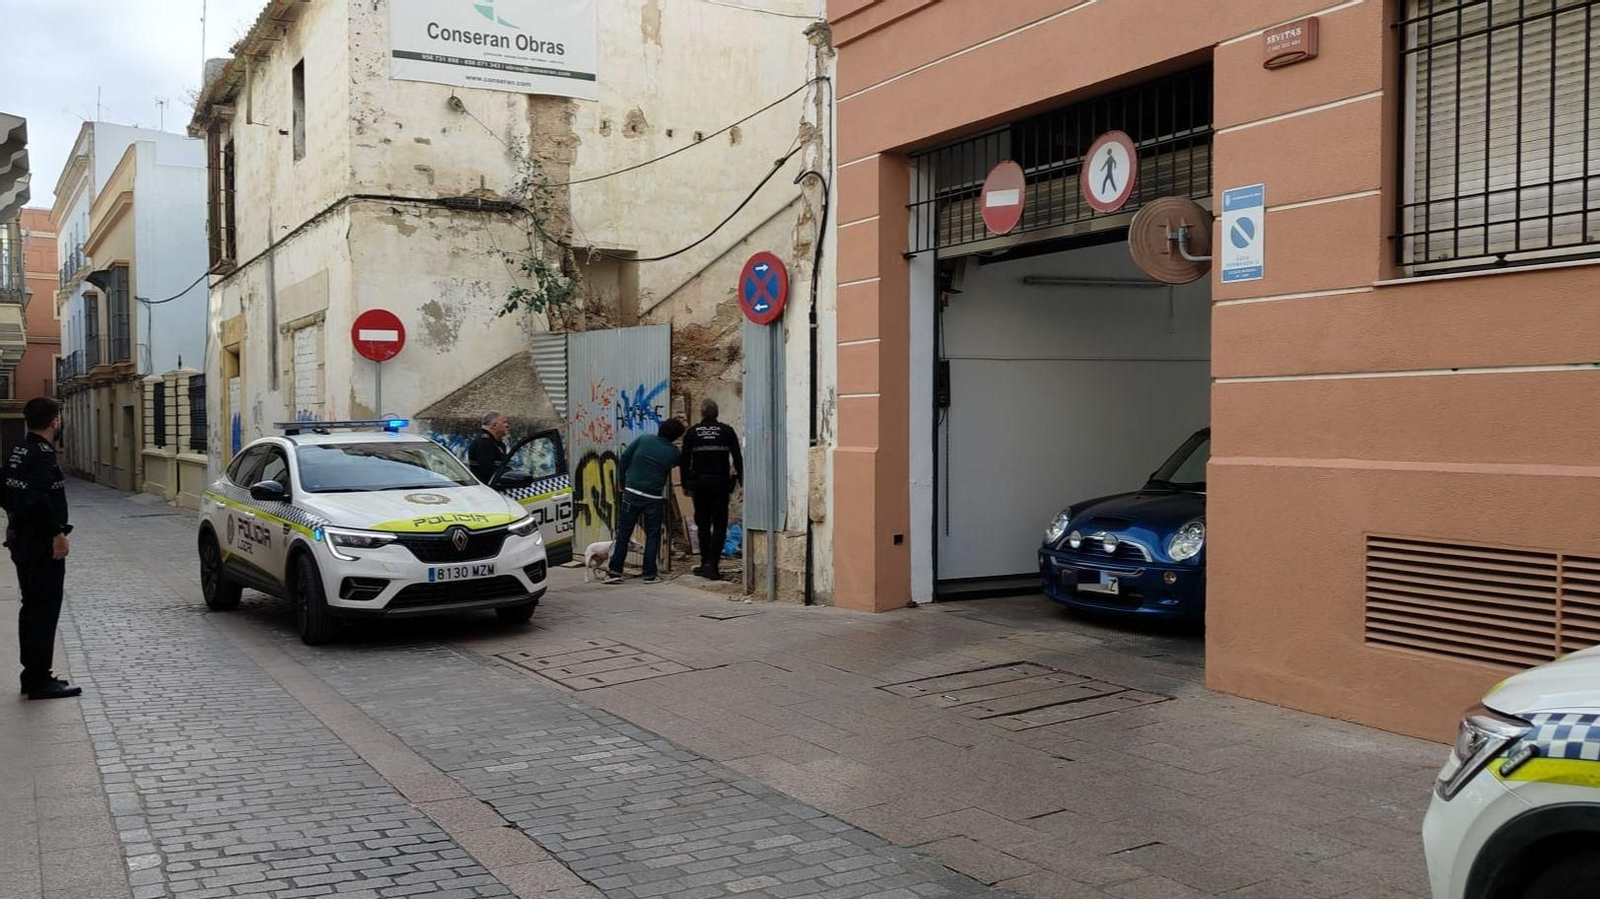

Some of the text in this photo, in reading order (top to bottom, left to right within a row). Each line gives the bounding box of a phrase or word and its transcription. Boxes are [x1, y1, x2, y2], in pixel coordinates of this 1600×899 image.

[427, 22, 565, 56] Conseran Obras
[465, 75, 532, 87] www.conseran.com
[437, 564, 495, 580] 8130 MZM
